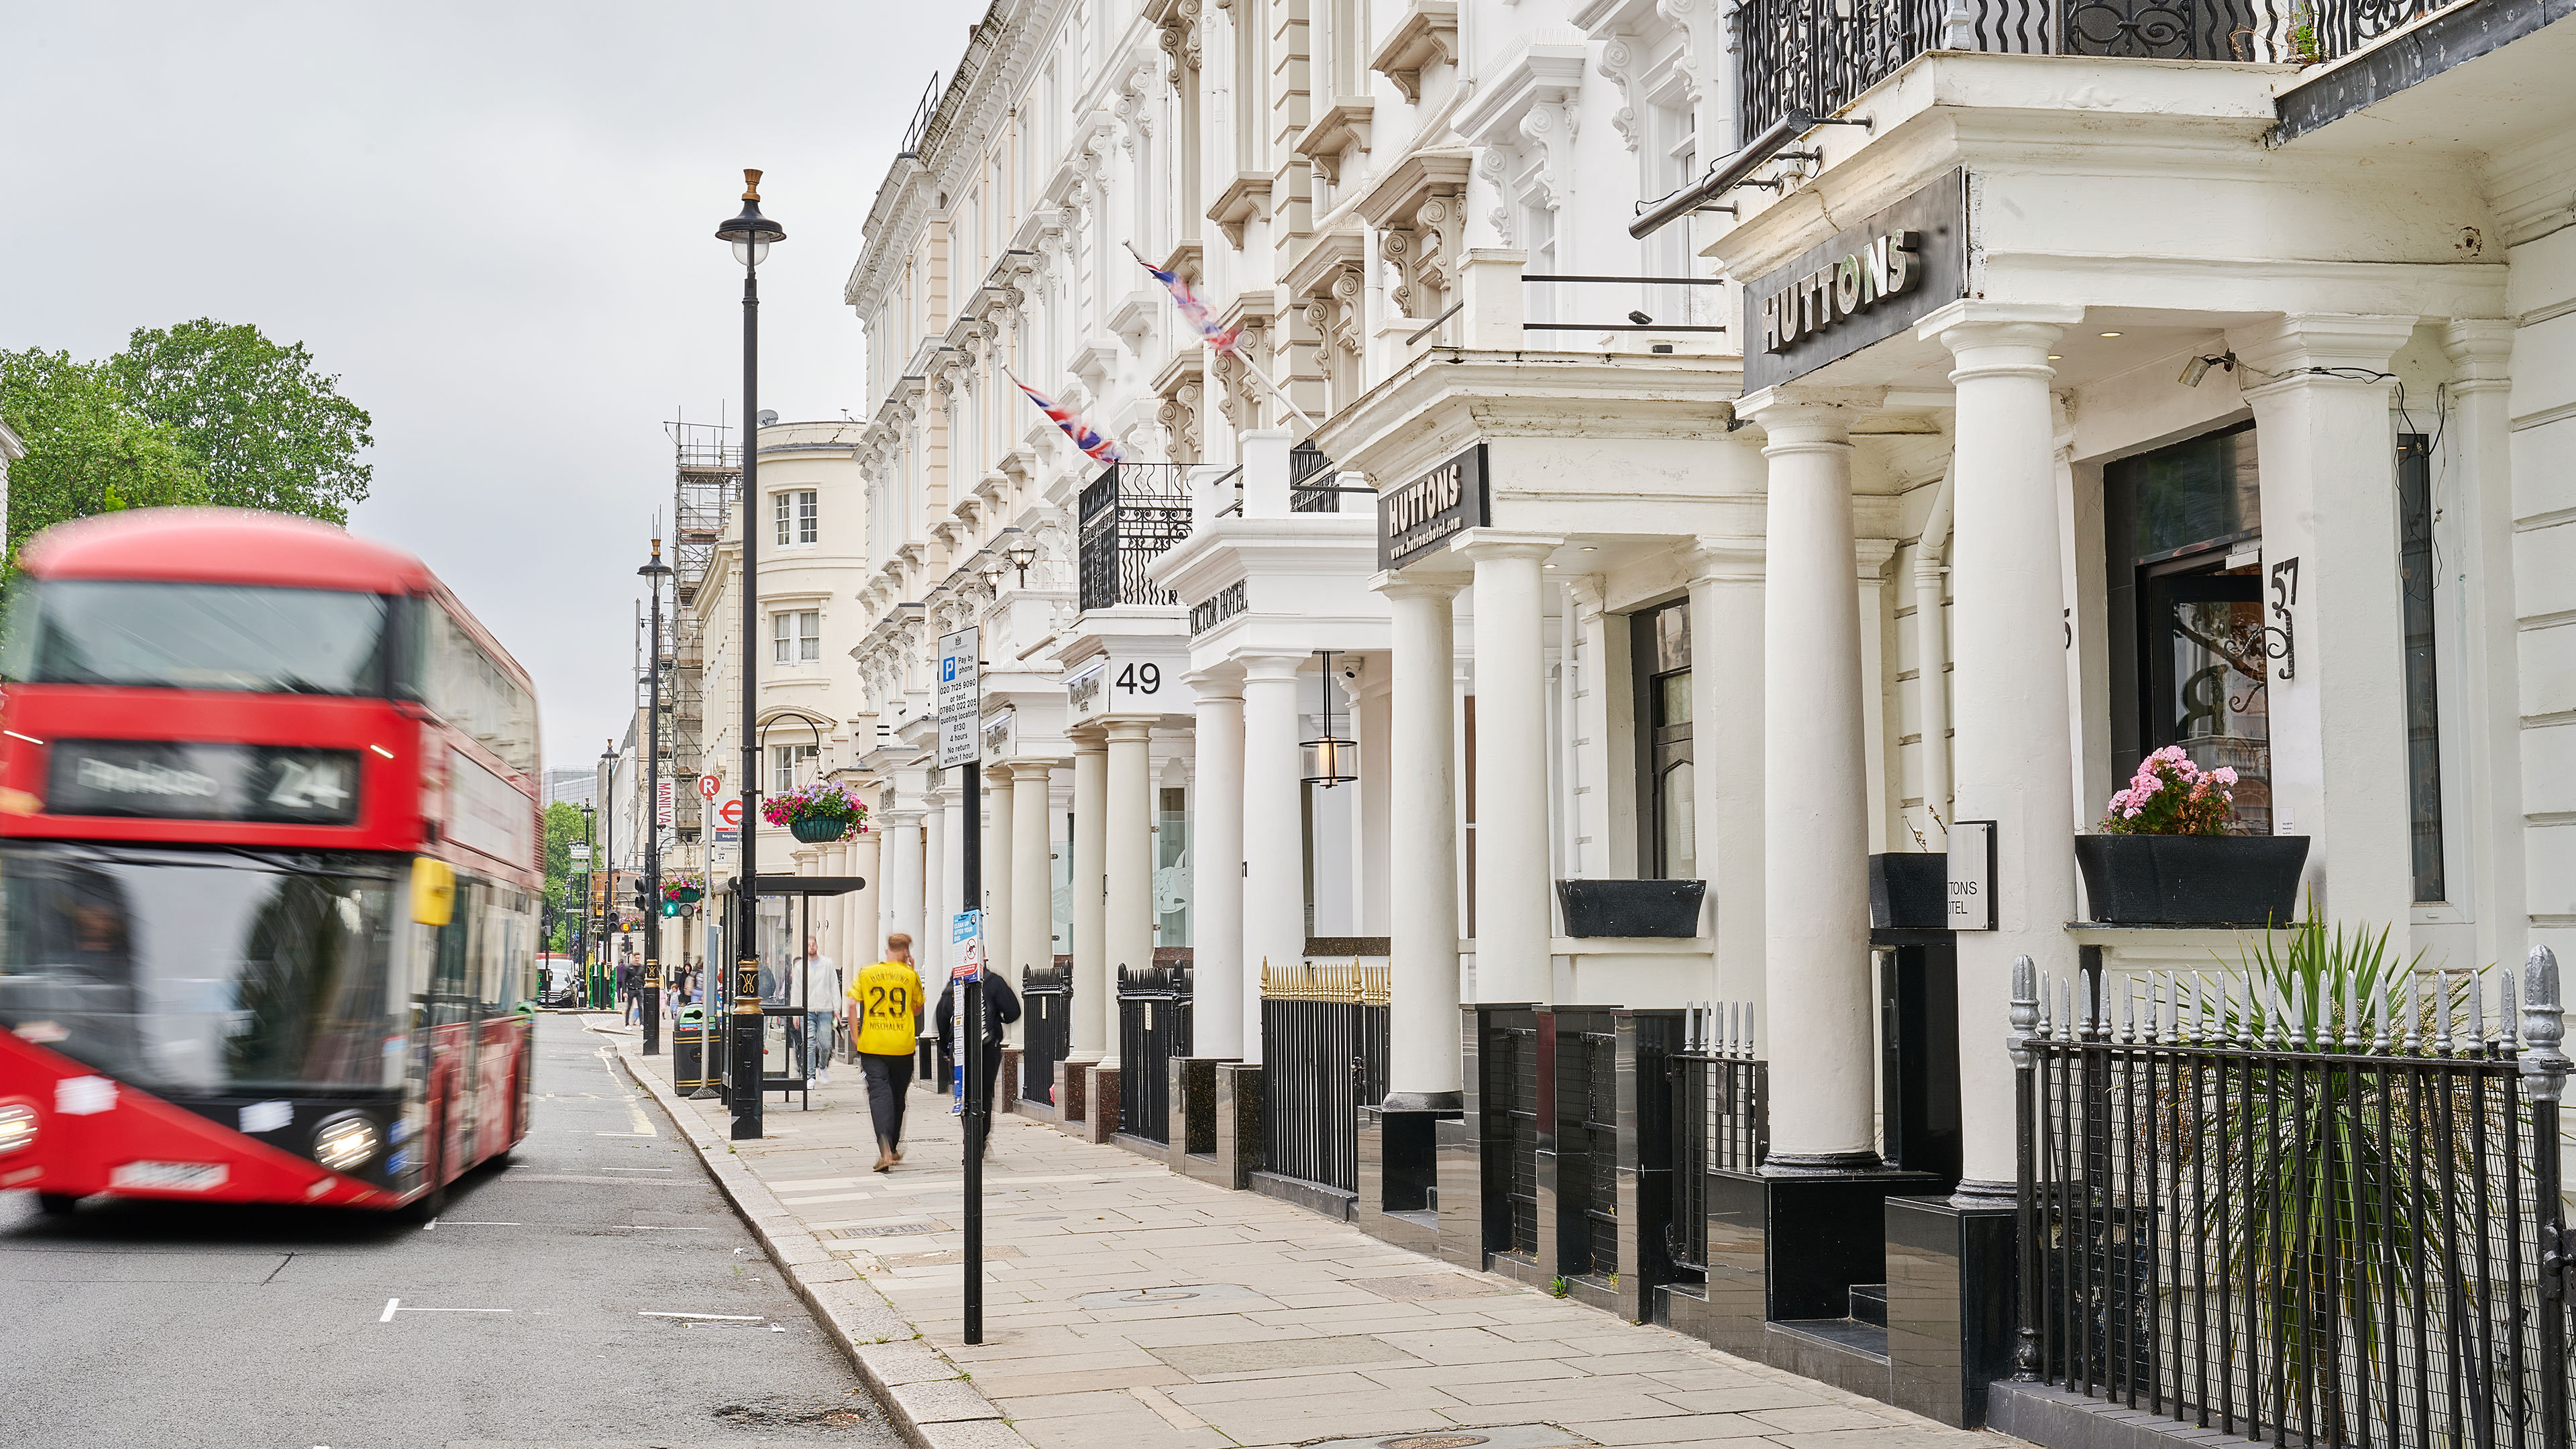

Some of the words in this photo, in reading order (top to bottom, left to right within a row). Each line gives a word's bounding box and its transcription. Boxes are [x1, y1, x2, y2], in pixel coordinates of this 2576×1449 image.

[1762, 229, 1913, 354] HUTTONS
[1389, 464, 1460, 537] HUTTONS
[1390, 516, 1462, 560] www.huttonshotel.com
[2271, 557, 2299, 609] 57
[1189, 596, 1218, 638] VICTOR
[1220, 579, 1248, 623] HOTEL
[946, 660, 953, 680] P
[959, 665, 973, 675] phone
[1116, 663, 1161, 694] 49
[940, 686, 950, 695] 020
[951, 682, 961, 692] 7125
[963, 678, 976, 688] 9090
[956, 692, 966, 701] text
[940, 704, 955, 714] 07860
[956, 701, 966, 710] 022
[967, 698, 976, 707] 205
[941, 714, 957, 725] quoting
[959, 709, 977, 720] location
[953, 722, 965, 732] 8130
[955, 733, 968, 741] hours
[955, 743, 970, 752] return
[944, 755, 958, 764] within
[963, 752, 974, 760] hour
[704, 778, 715, 794] R
[658, 783, 672, 824] MANILVA
[869, 986, 906, 1016] 29
